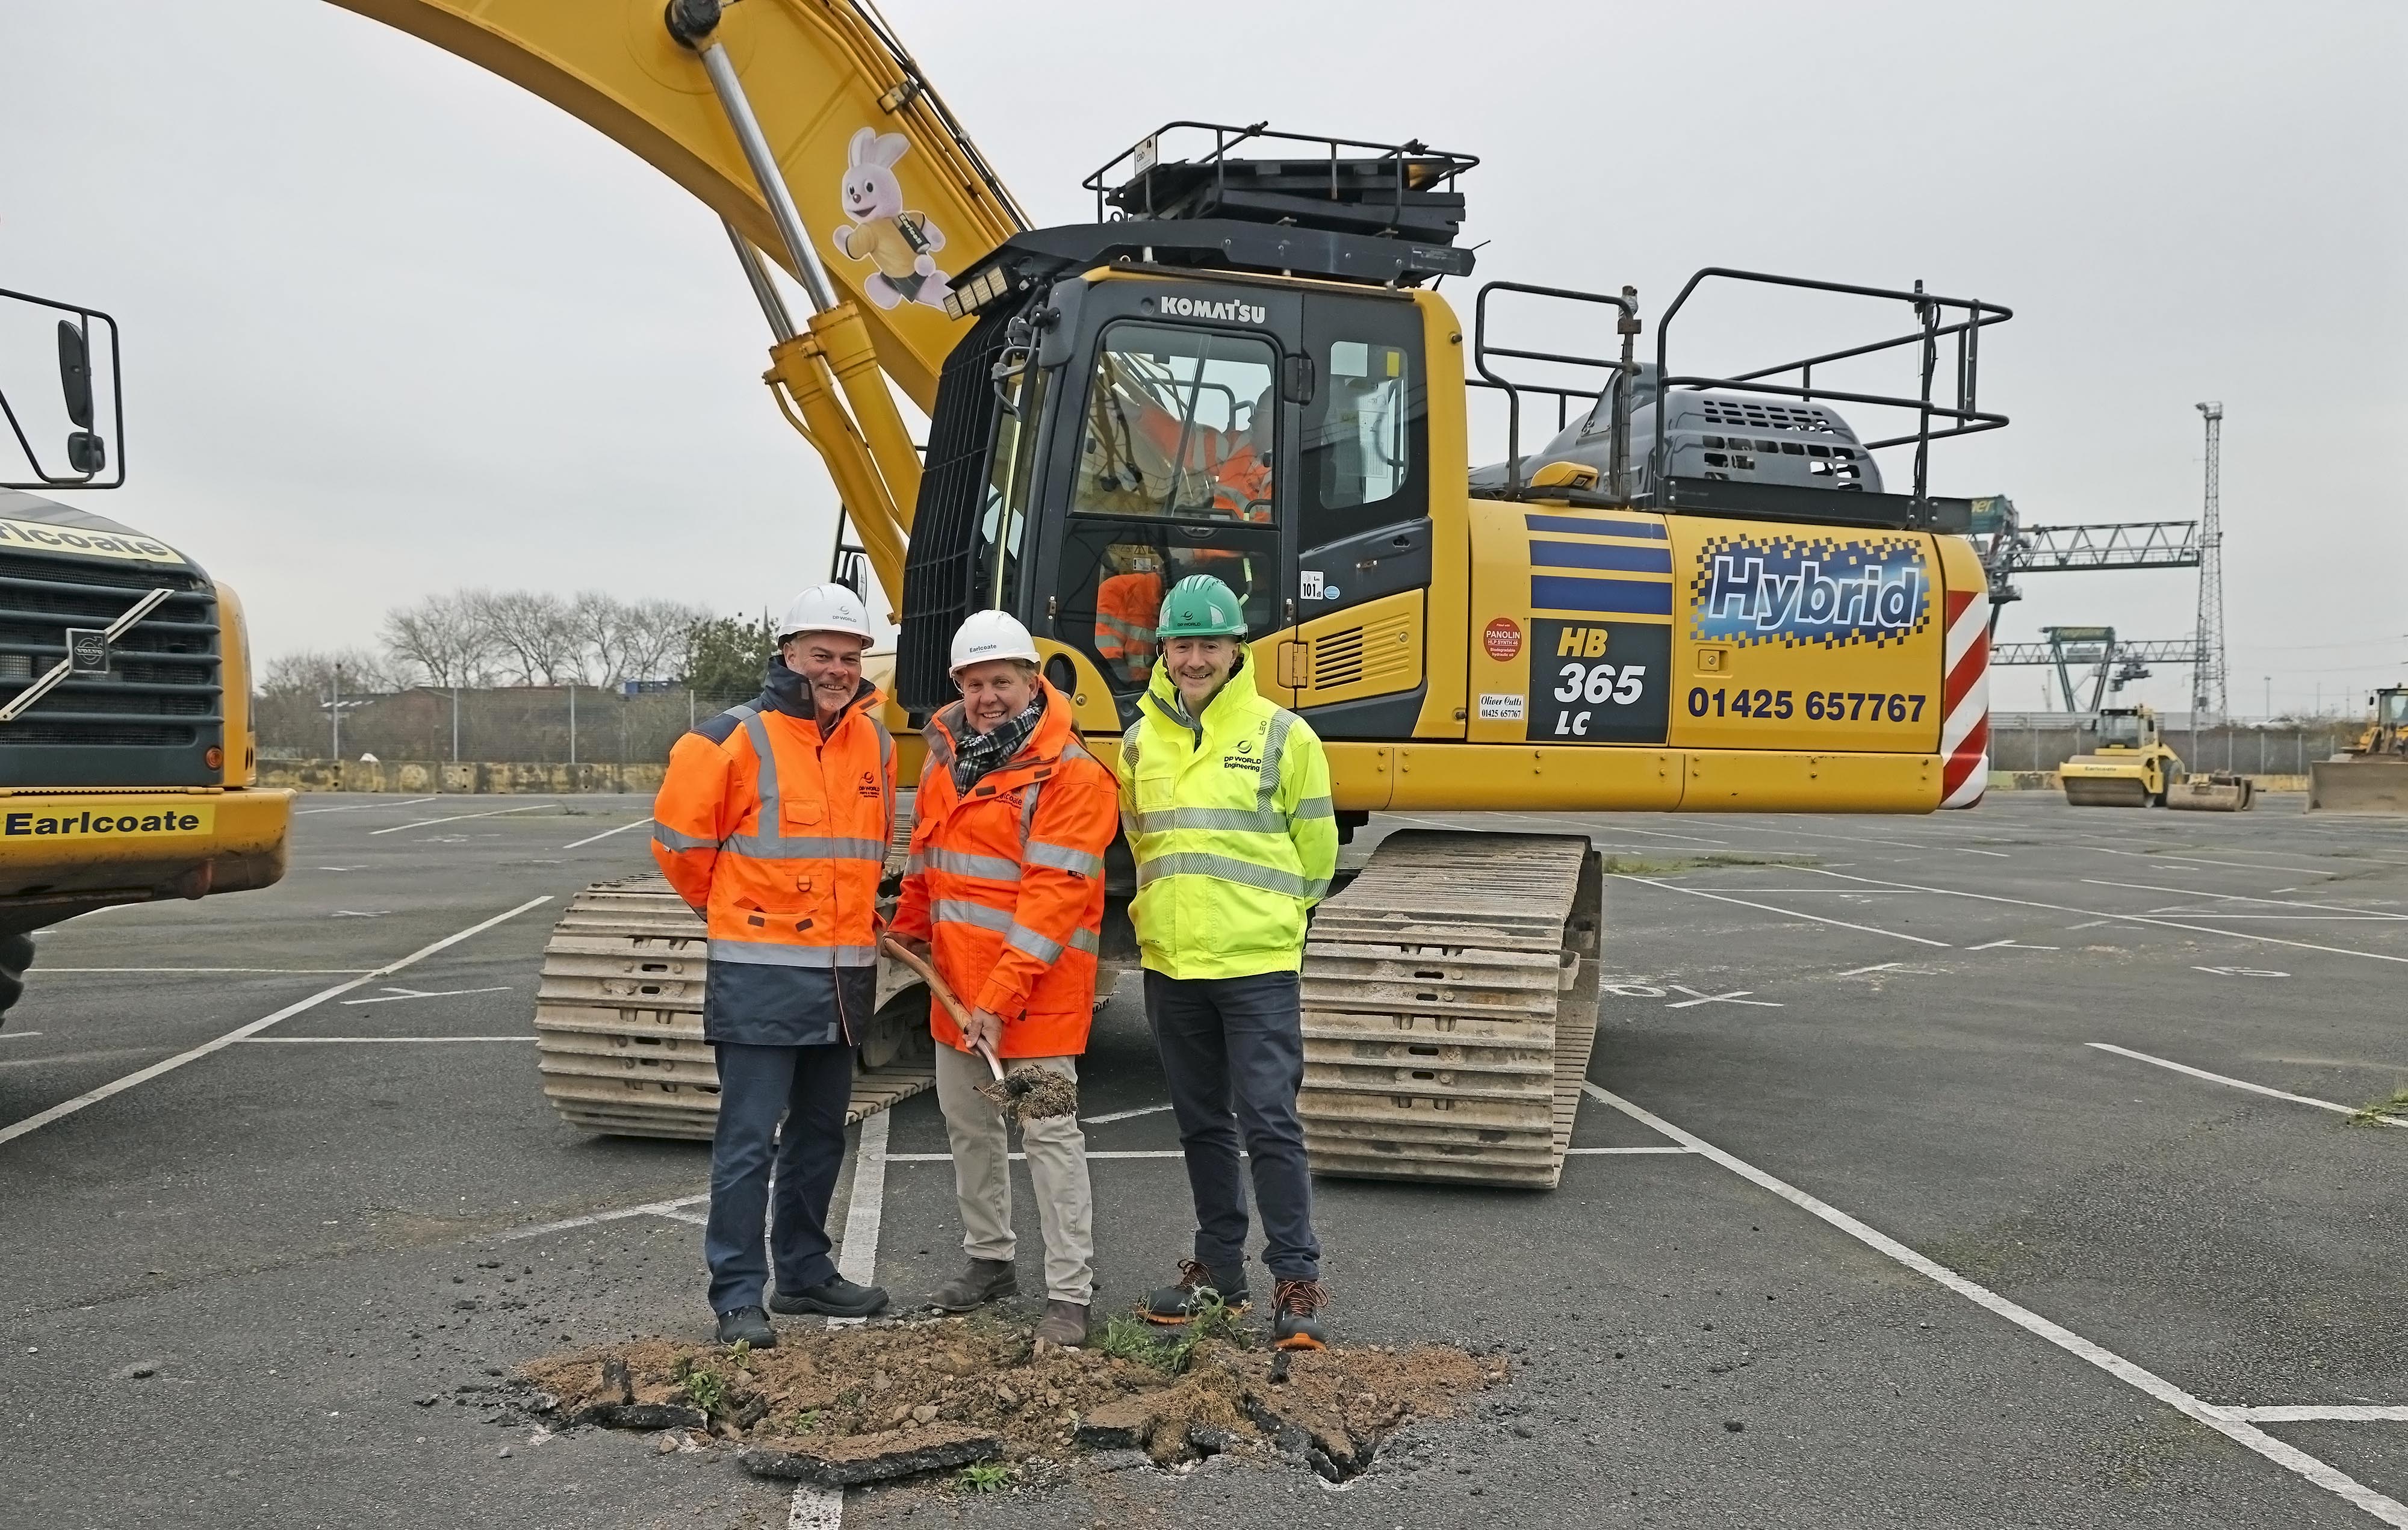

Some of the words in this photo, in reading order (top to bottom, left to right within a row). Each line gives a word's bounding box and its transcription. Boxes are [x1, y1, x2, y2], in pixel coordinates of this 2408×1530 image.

[1161, 296, 1265, 324] KOMATSU
[1303, 583, 1316, 597] 101
[1708, 554, 1920, 630] Hybrid
[1486, 630, 1521, 639] PANOLIN
[1557, 627, 1609, 657] HB
[969, 644, 997, 653] Earlcoate
[1554, 663, 1646, 705] 365
[1481, 696, 1503, 705] Oliver
[1504, 696, 1522, 706] Cutts
[1688, 687, 1793, 719] 01425
[1805, 690, 1926, 722] 657767
[1482, 709, 1498, 717] 01425
[1500, 710, 1521, 718] 657767
[1258, 720, 1267, 736] LEO
[1554, 711, 1592, 736] LC
[1224, 762, 1261, 772] Engineering
[1235, 756, 1262, 764] WORLD
[5, 811, 199, 835] Earlcoate
